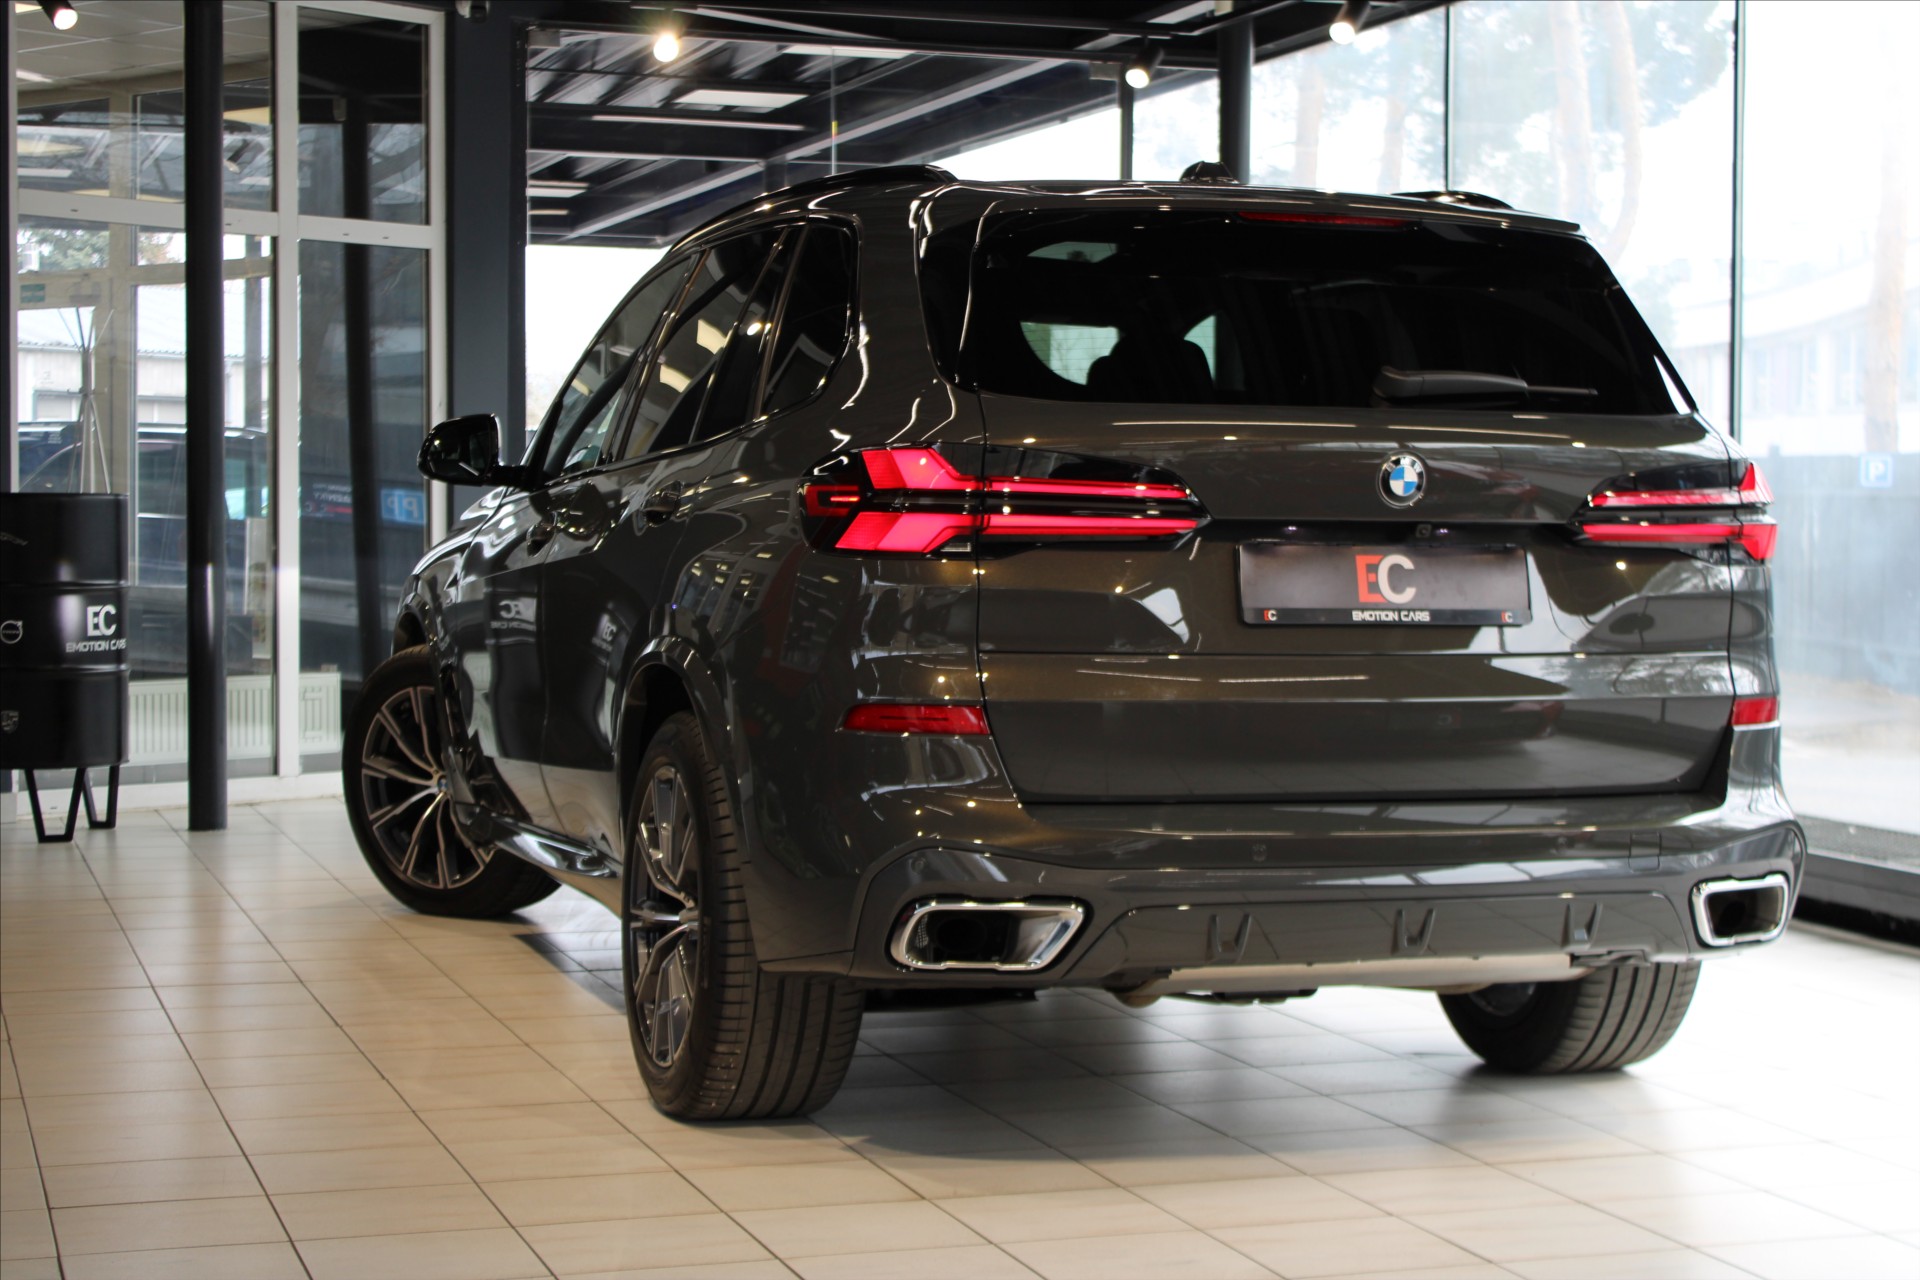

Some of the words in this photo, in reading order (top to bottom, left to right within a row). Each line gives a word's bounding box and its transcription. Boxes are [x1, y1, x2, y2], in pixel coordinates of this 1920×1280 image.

[1355, 554, 1417, 604] EC
[87, 604, 117, 637] EC
[1352, 610, 1399, 622] EMOTION
[1400, 610, 1430, 622] CARS
[65, 640, 109, 653] EMOTION
